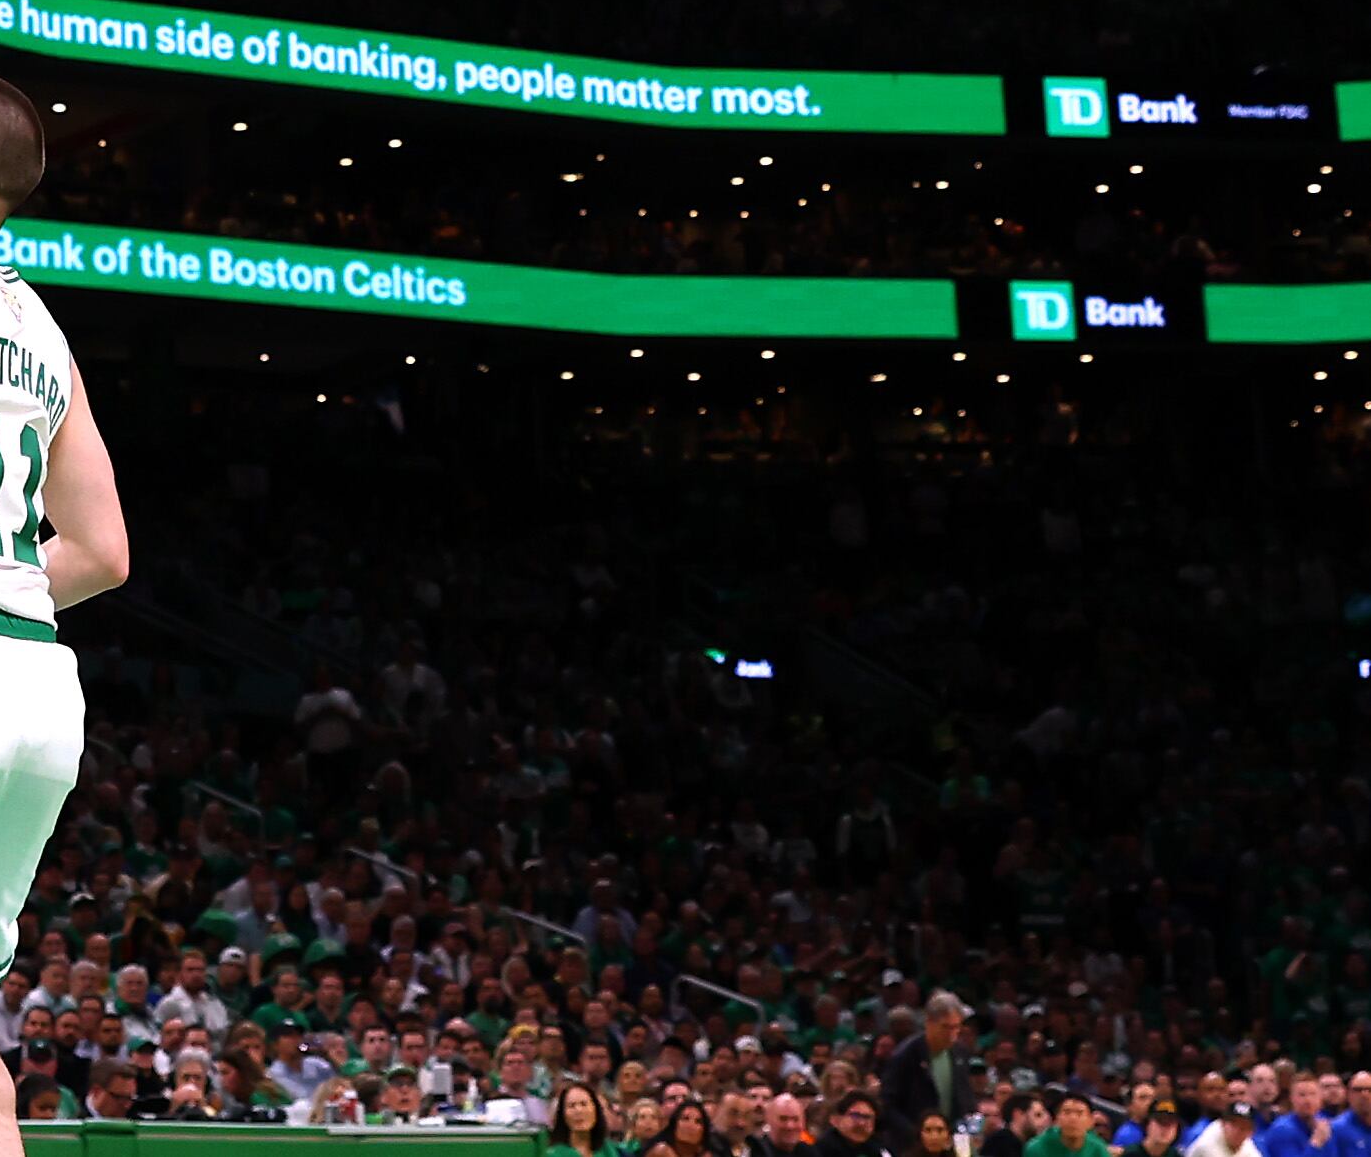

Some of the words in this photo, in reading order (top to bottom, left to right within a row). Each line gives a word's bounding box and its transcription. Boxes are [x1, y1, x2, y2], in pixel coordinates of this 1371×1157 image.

[156, 19, 234, 60] side
[242, 30, 280, 65] of
[289, 32, 447, 91] banking,
[455, 62, 575, 101] people
[583, 77, 702, 112] matter
[712, 86, 821, 115] most.
[1049, 87, 1103, 126] TD
[1118, 93, 1197, 124] Bank
[93, 239, 131, 274] of
[140, 243, 200, 280] the
[210, 249, 335, 292] Boston
[344, 262, 466, 305] Celtics
[1016, 291, 1070, 330] TD
[1085, 296, 1165, 328] Bank
